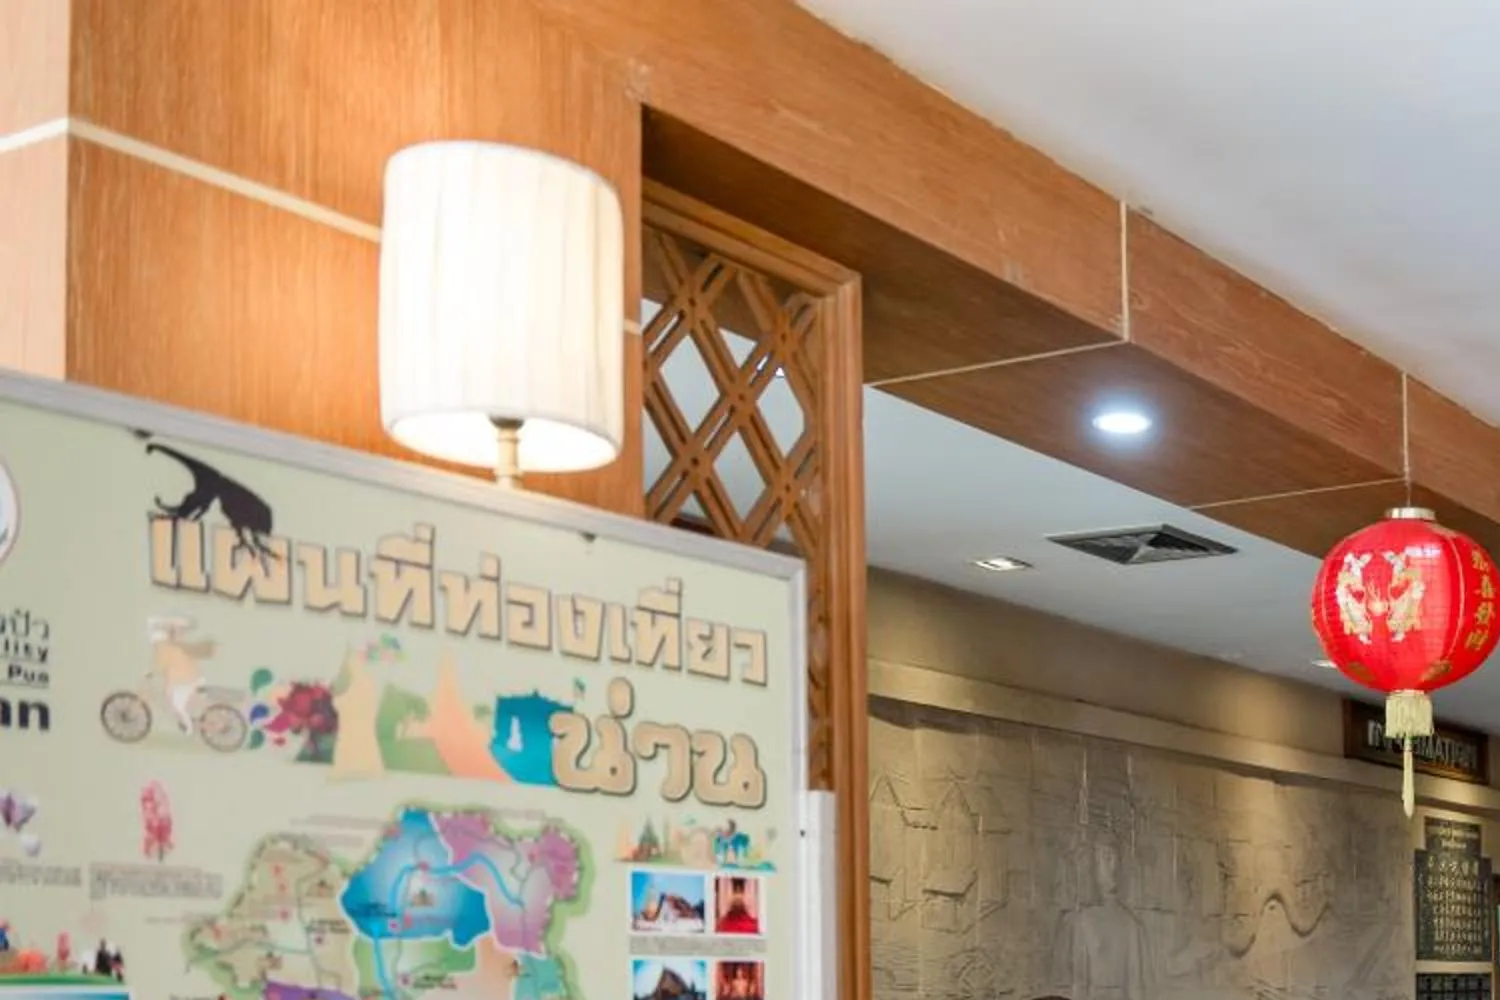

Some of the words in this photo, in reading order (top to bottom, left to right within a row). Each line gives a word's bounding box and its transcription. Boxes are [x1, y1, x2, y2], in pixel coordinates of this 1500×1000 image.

[149, 517, 769, 688] แผนที่ท่องเที่ยว
[550, 676, 768, 808] น่าน
